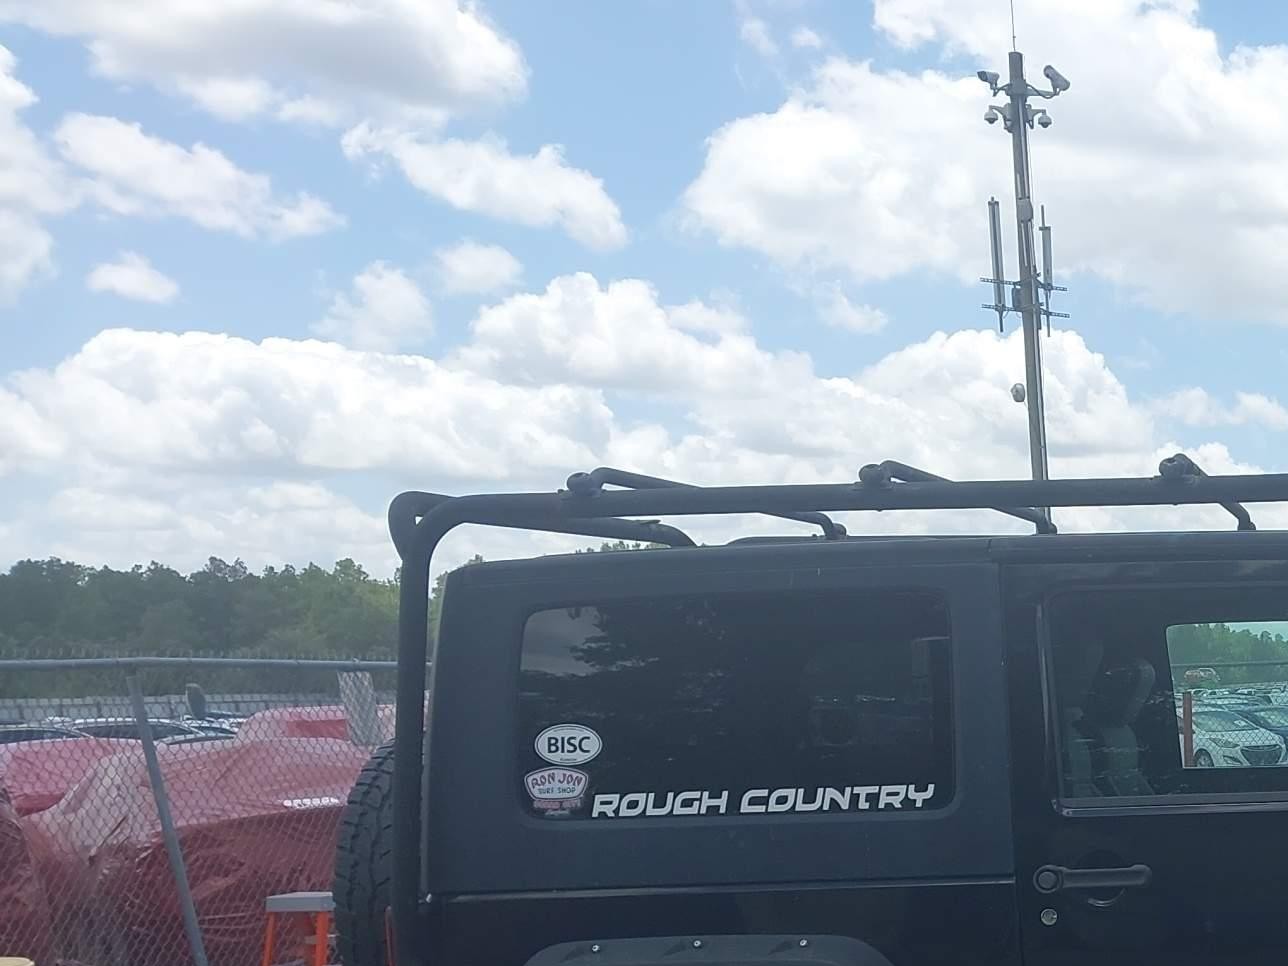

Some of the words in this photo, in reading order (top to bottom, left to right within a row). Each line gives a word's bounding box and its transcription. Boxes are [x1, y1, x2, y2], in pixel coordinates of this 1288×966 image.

[547, 736, 591, 754] BISC
[531, 772, 556, 789] RON
[558, 773, 583, 787] JON
[557, 786, 576, 794] SHOP
[591, 790, 728, 818] ROUGH
[739, 784, 935, 814] COUNTRY
